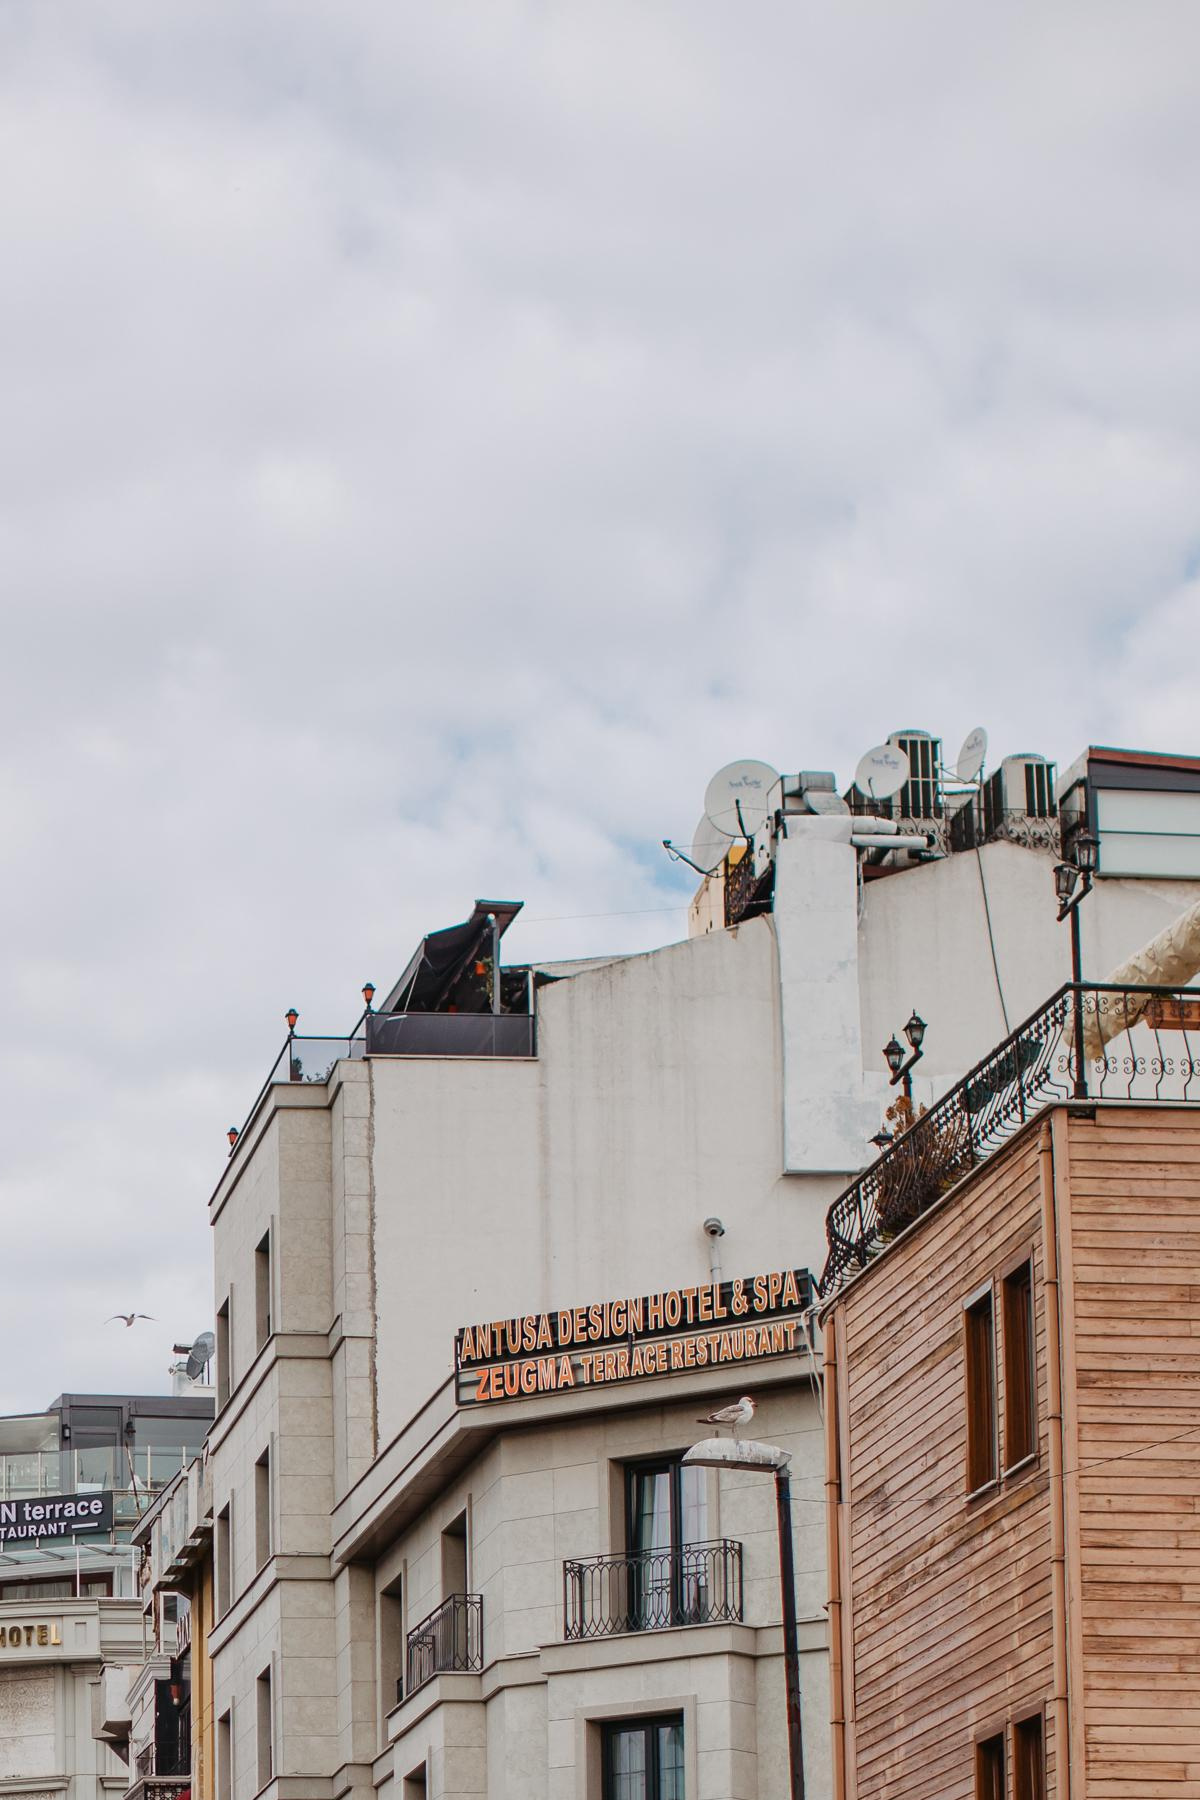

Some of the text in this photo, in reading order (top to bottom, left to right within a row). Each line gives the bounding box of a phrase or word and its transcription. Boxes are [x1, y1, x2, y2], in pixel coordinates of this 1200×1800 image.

[461, 1270, 800, 1362] ANTUSA DESIGN HOTEL & SPA
[475, 1321, 797, 1401] ZEUGMA TERRACE RESTAURANT
[23, 1499, 103, 1521] terrace
